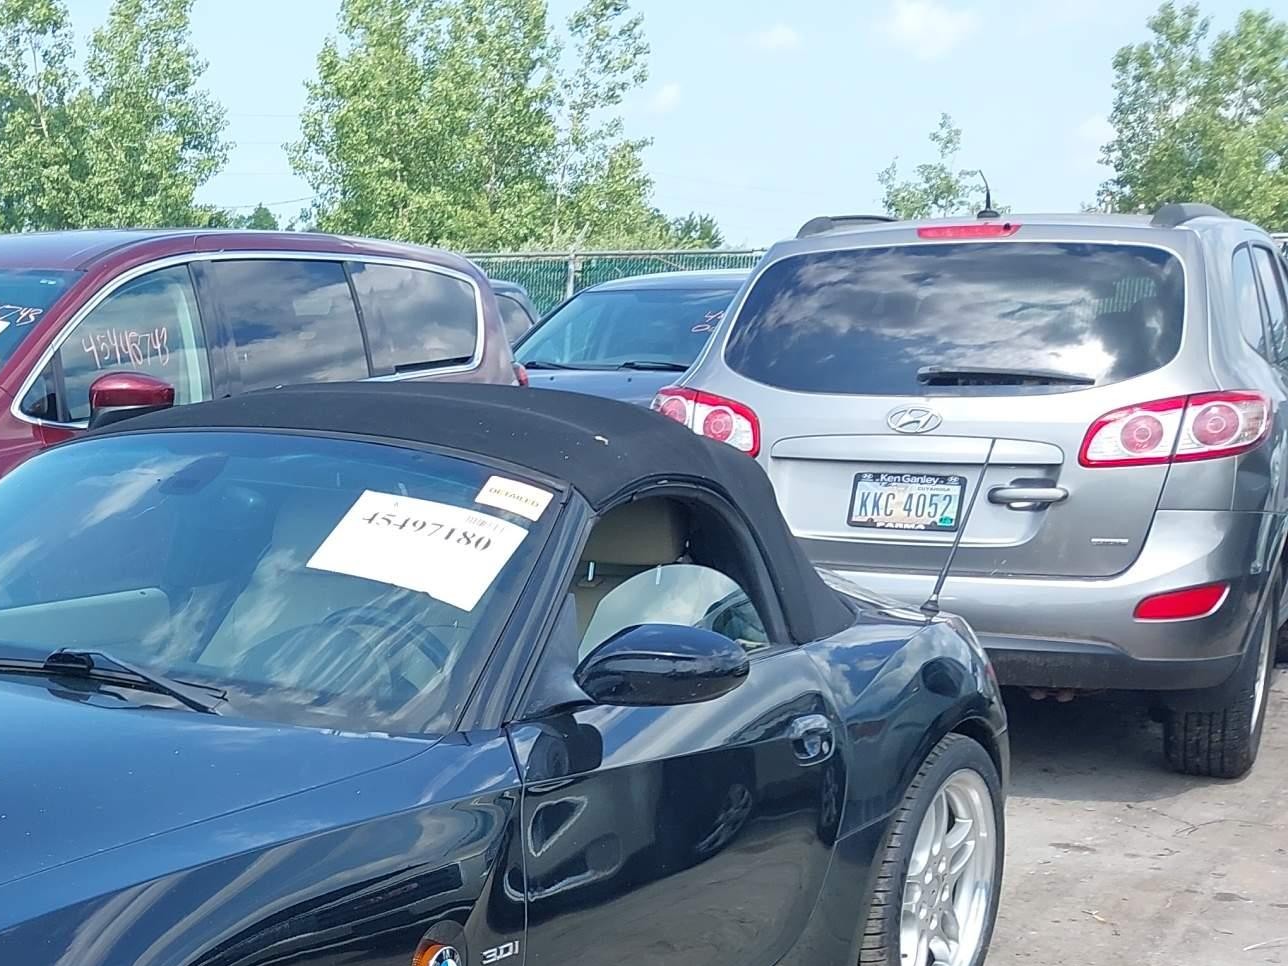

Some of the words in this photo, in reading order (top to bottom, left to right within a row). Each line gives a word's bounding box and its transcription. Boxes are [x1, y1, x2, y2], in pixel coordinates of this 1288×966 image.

[880, 473, 901, 483] Ken
[901, 474, 940, 486] Ganley
[859, 492, 896, 518] KKC
[903, 493, 953, 519] 4052
[362, 510, 493, 552] 45497180
